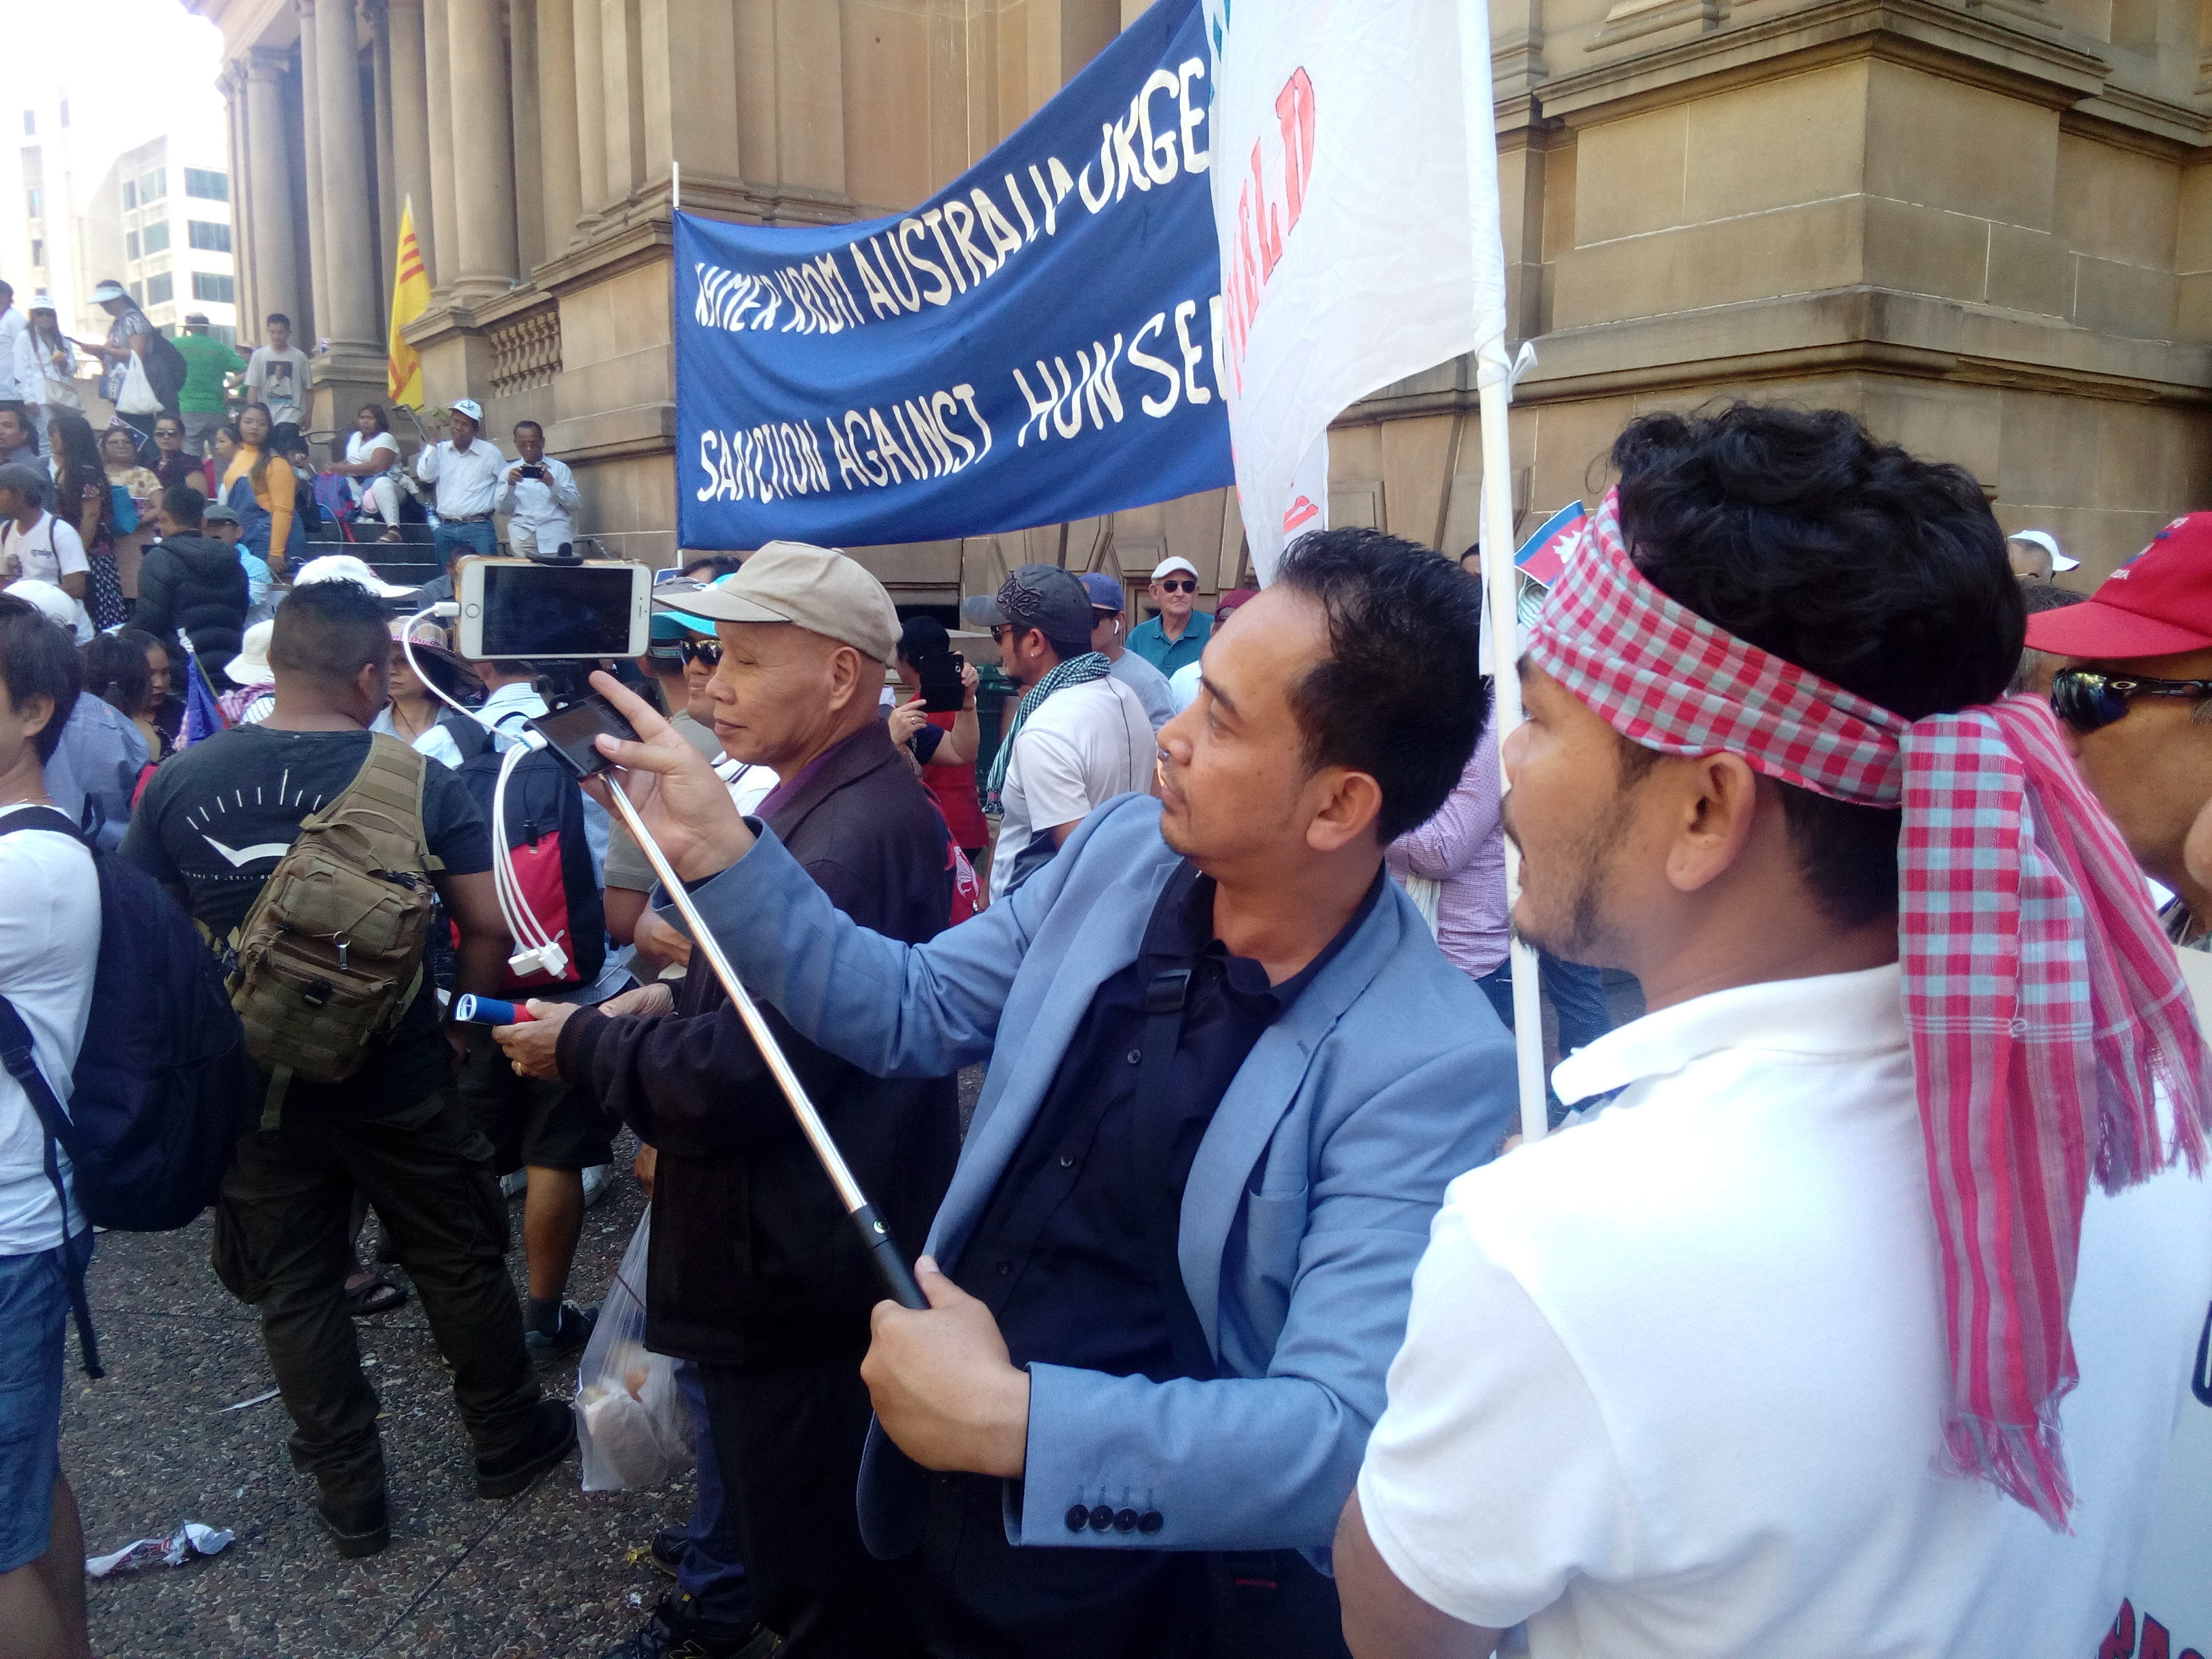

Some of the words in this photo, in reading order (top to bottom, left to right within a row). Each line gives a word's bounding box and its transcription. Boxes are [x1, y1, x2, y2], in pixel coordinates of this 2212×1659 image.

[849, 156, 1074, 321] AUSTRALIA
[697, 419, 831, 504] SANCTION
[826, 383, 993, 491] AGAINST
[1012, 332, 1124, 448] HUN
